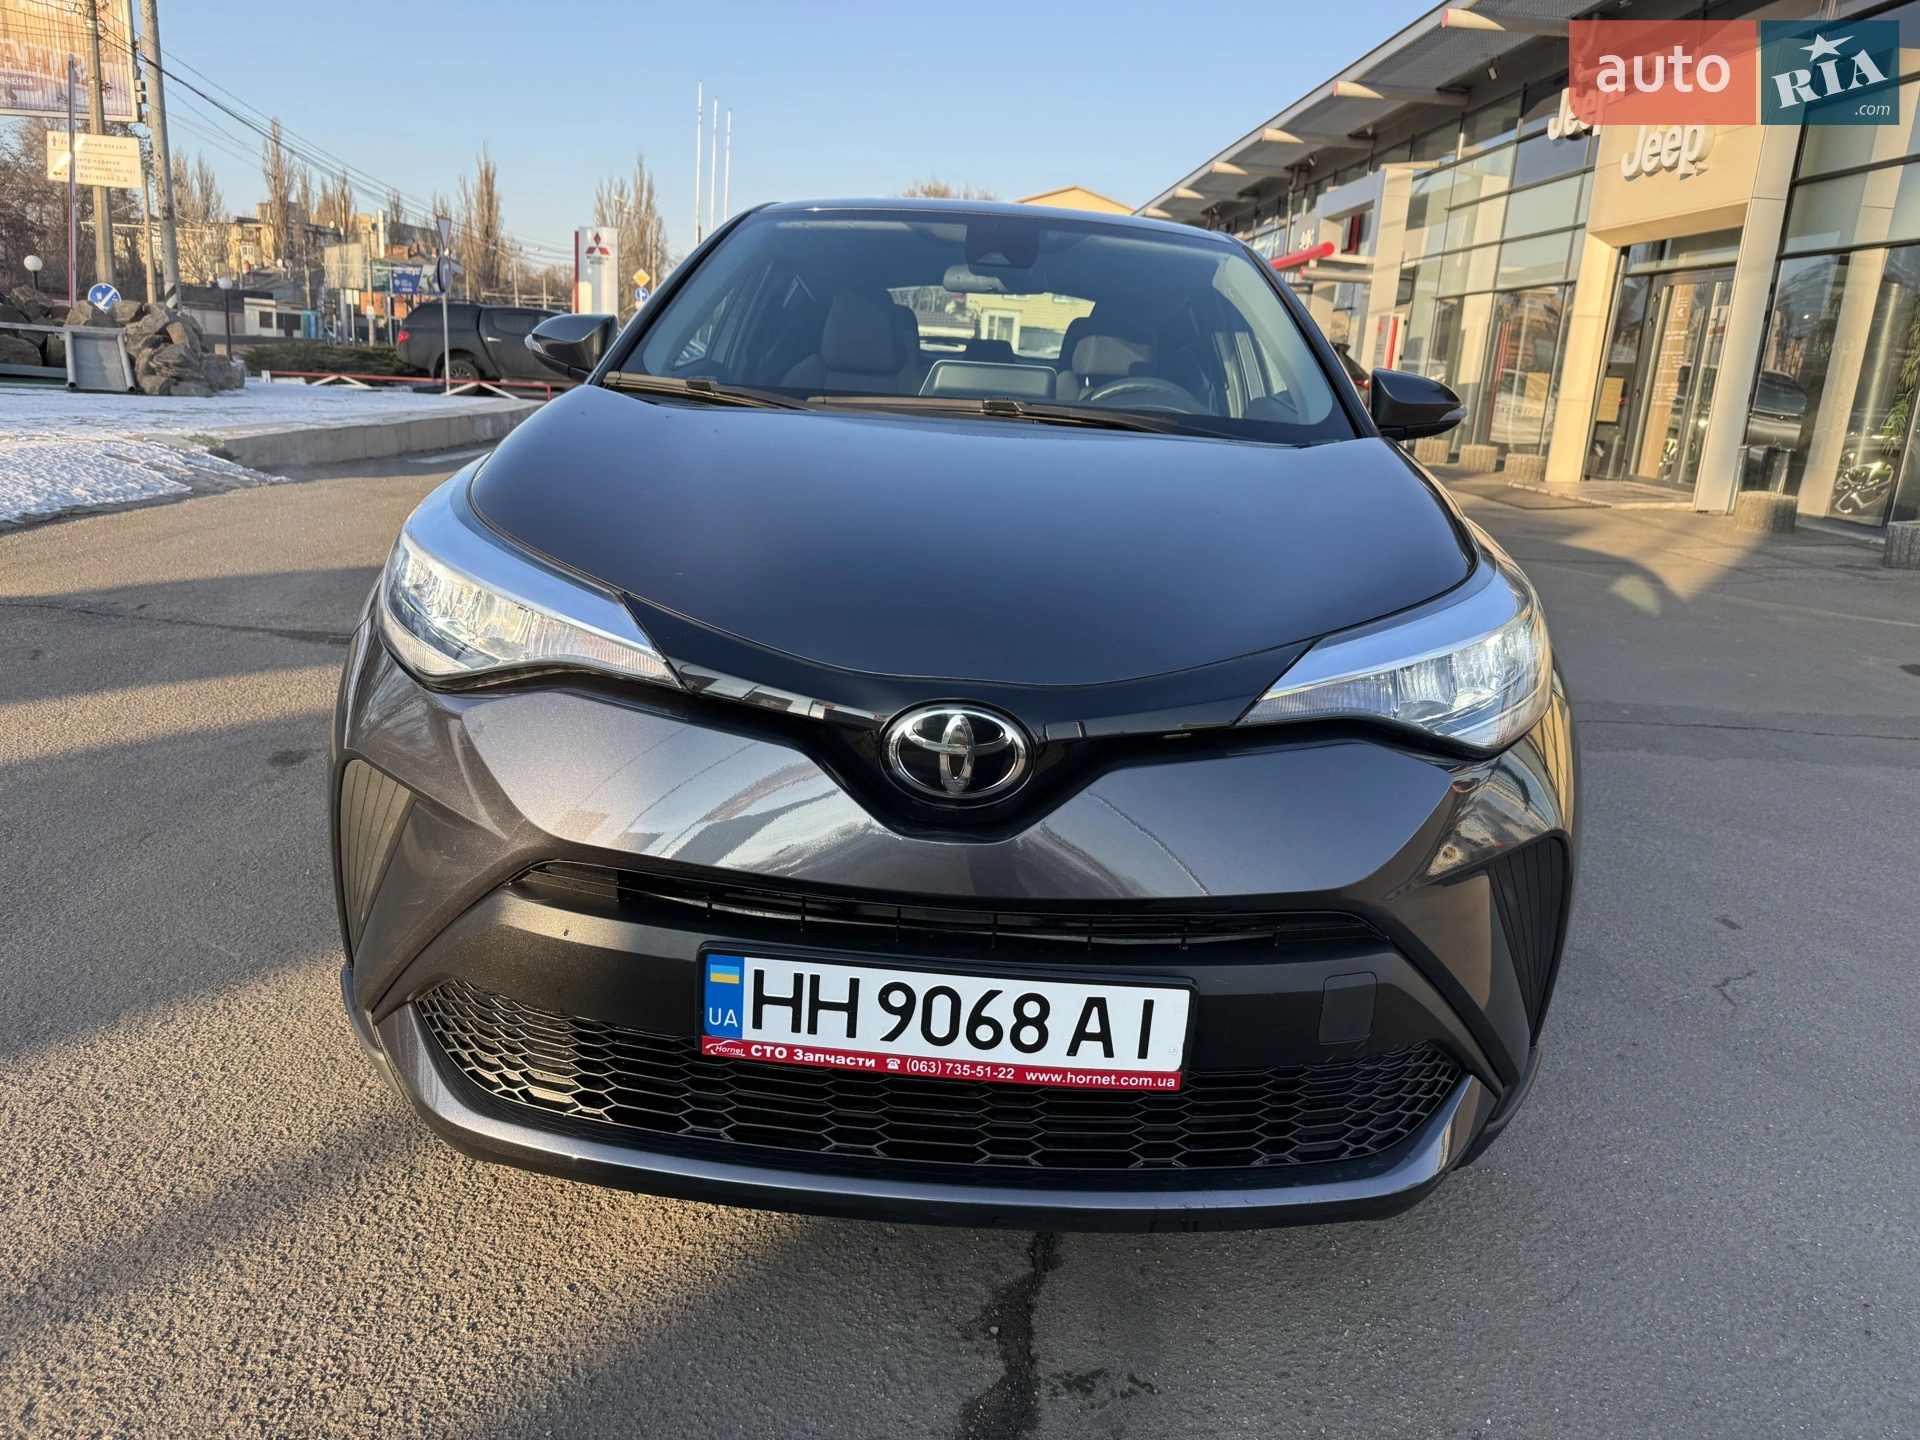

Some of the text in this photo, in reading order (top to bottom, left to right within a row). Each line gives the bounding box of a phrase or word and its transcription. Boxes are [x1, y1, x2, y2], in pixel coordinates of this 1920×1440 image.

[1620, 118, 1713, 178] Jeep
[708, 969, 1155, 1060] UA HH 9068 AI
[714, 1043, 1176, 1088] Hornet СТО Запчасти (063) 735-51-22 www.hornet.com.ua
